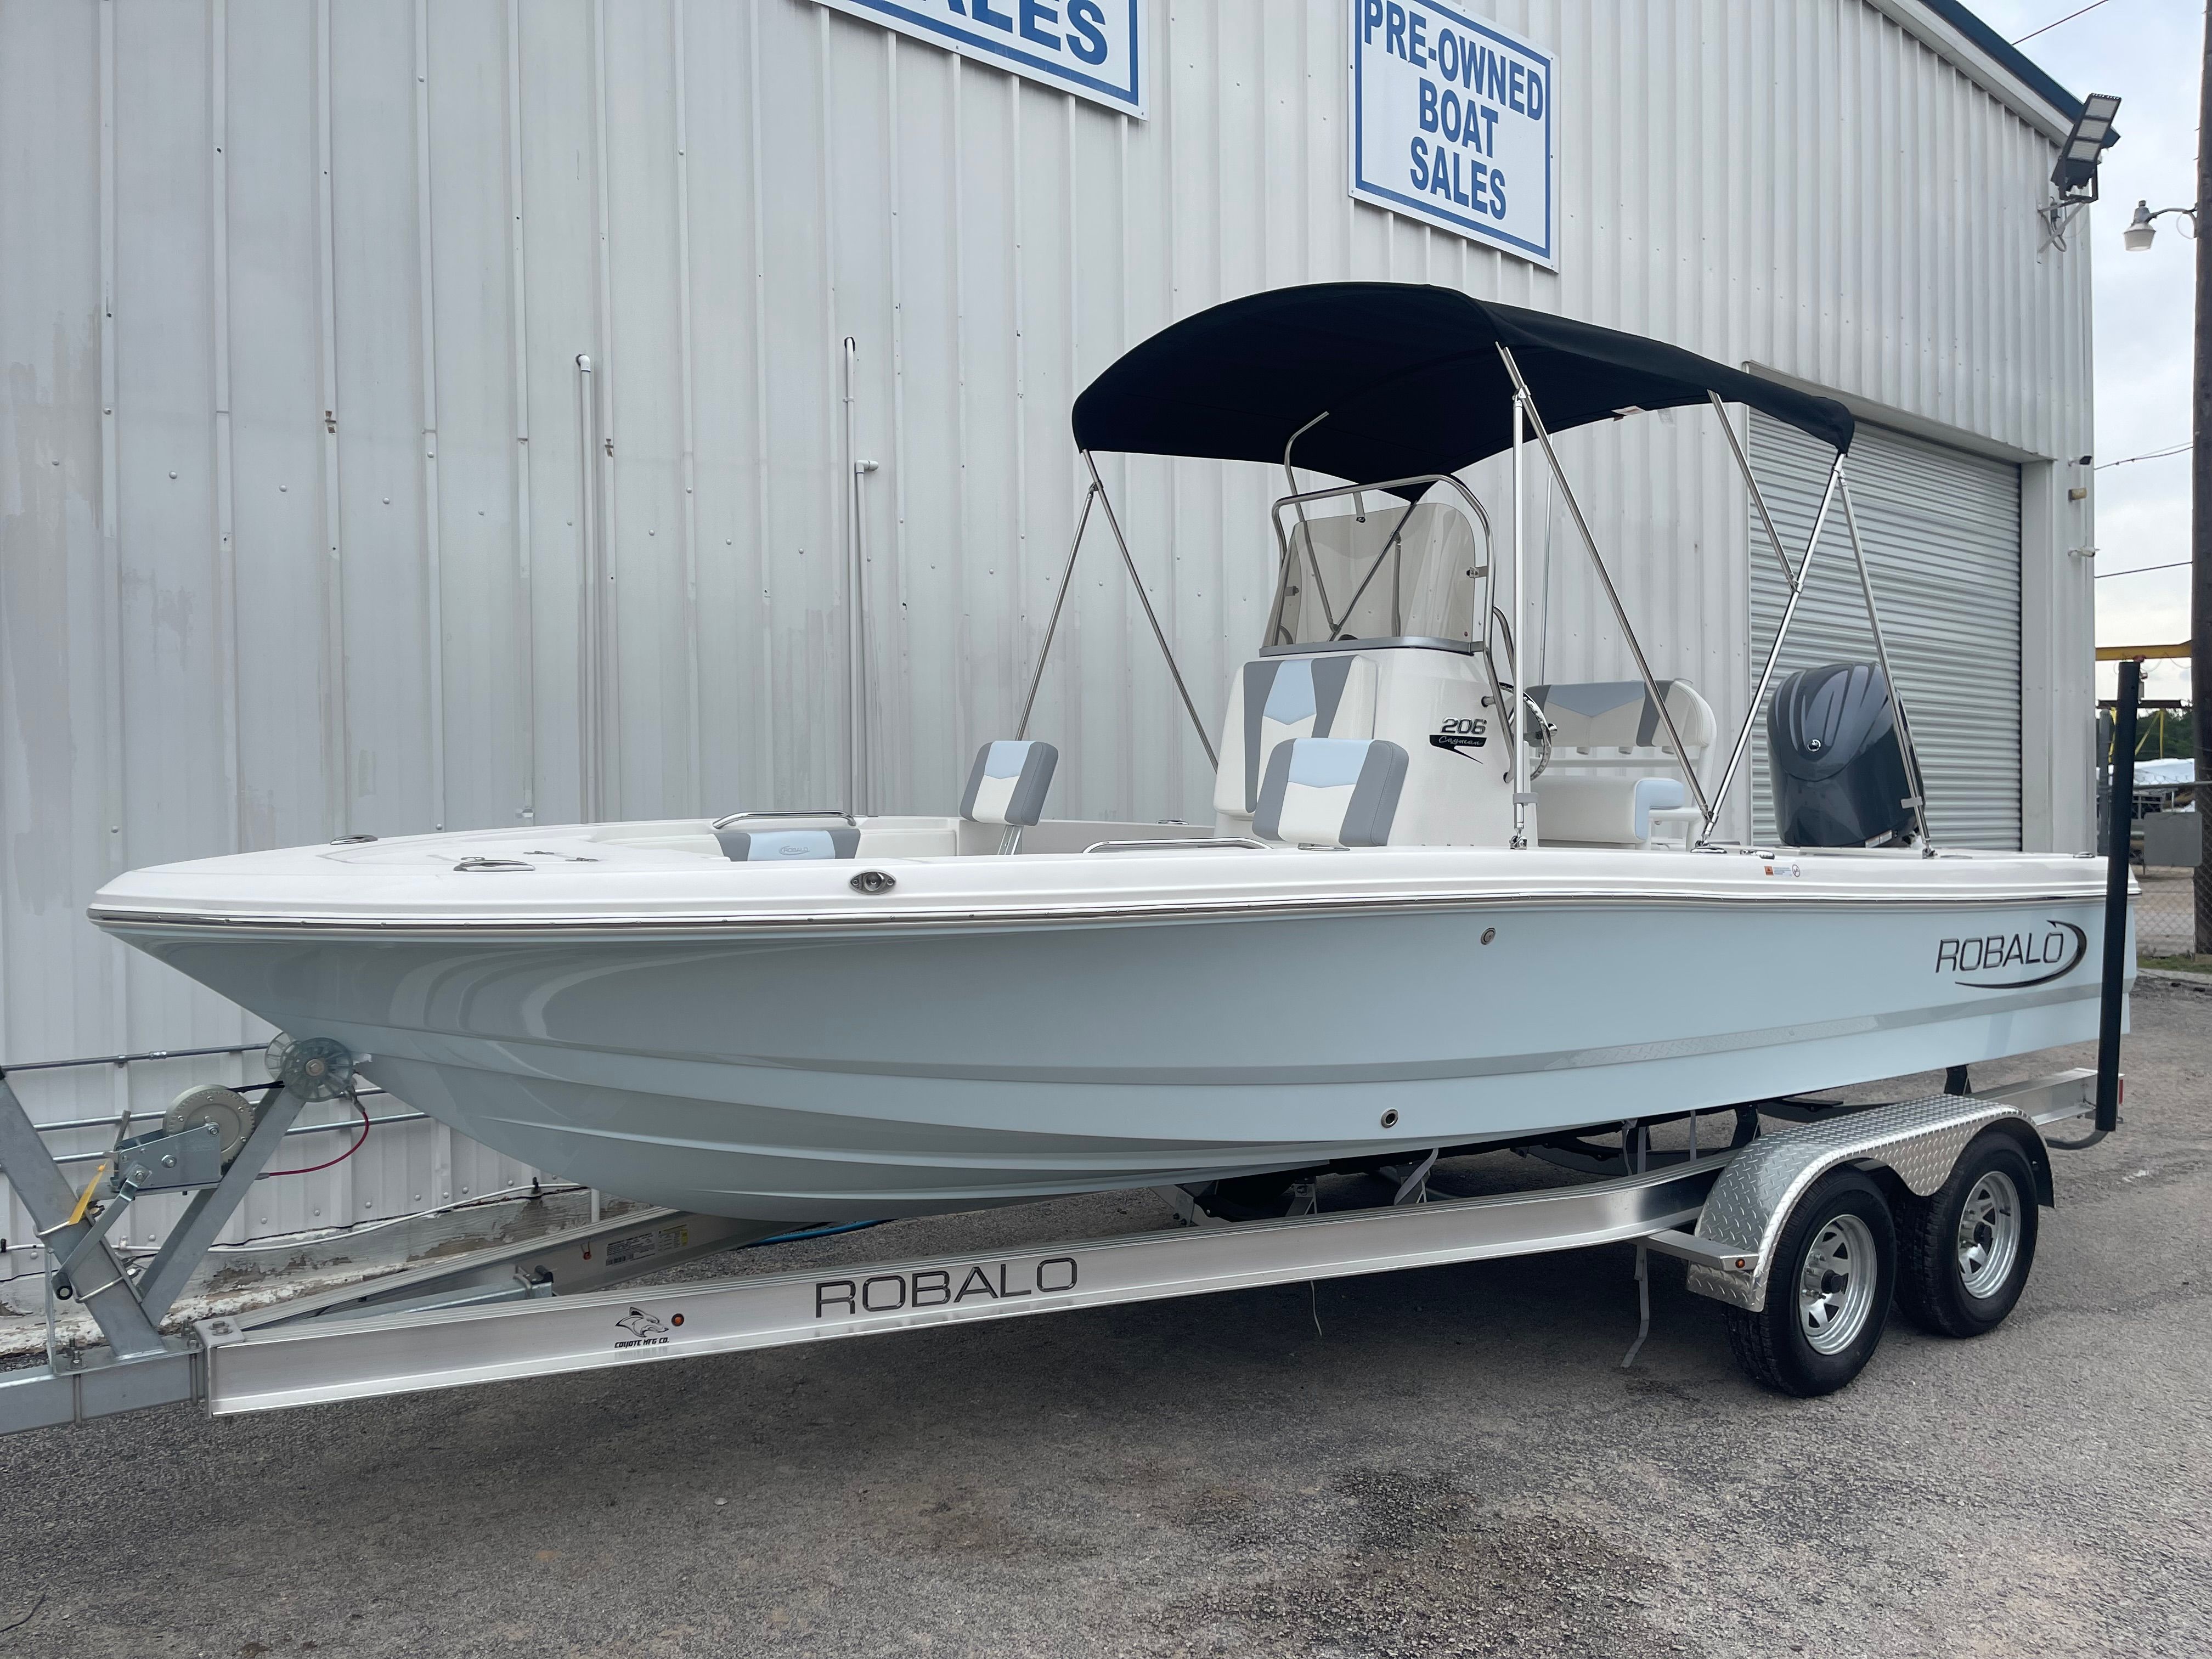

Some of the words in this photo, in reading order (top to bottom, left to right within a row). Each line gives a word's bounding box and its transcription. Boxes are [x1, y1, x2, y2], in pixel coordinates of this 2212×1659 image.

[1364, 0, 1543, 121] PRE-OWNED
[1419, 76, 1499, 159] BOAT
[1410, 136, 1506, 220] SALES
[1440, 716, 1487, 735] 206
[1935, 932, 2064, 973] ROBALO
[816, 1257, 1077, 1318] ROBALO
[614, 1340, 642, 1348] COYOTE
